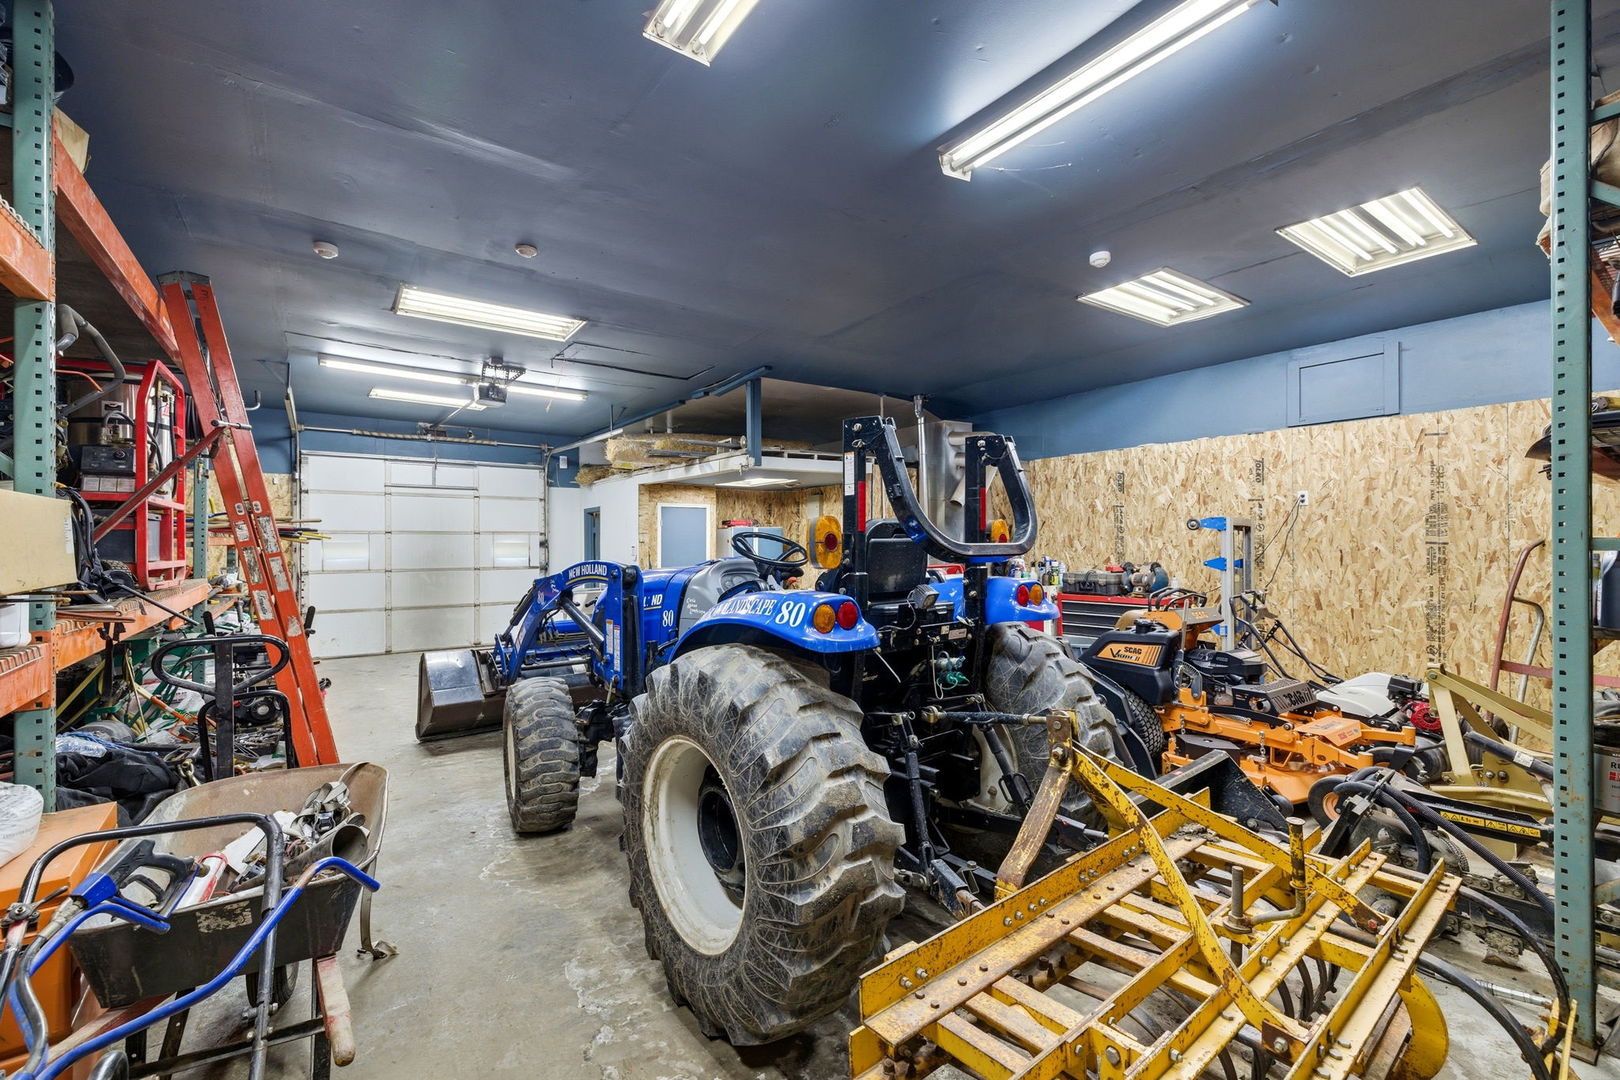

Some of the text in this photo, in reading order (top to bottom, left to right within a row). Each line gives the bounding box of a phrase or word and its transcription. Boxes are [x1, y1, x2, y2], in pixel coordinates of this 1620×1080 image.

[568, 563, 608, 580] NEW HOLLAND
[662, 609, 675, 627] 80
[775, 600, 806, 627] 80
[1123, 646, 1143, 655] SCAG
